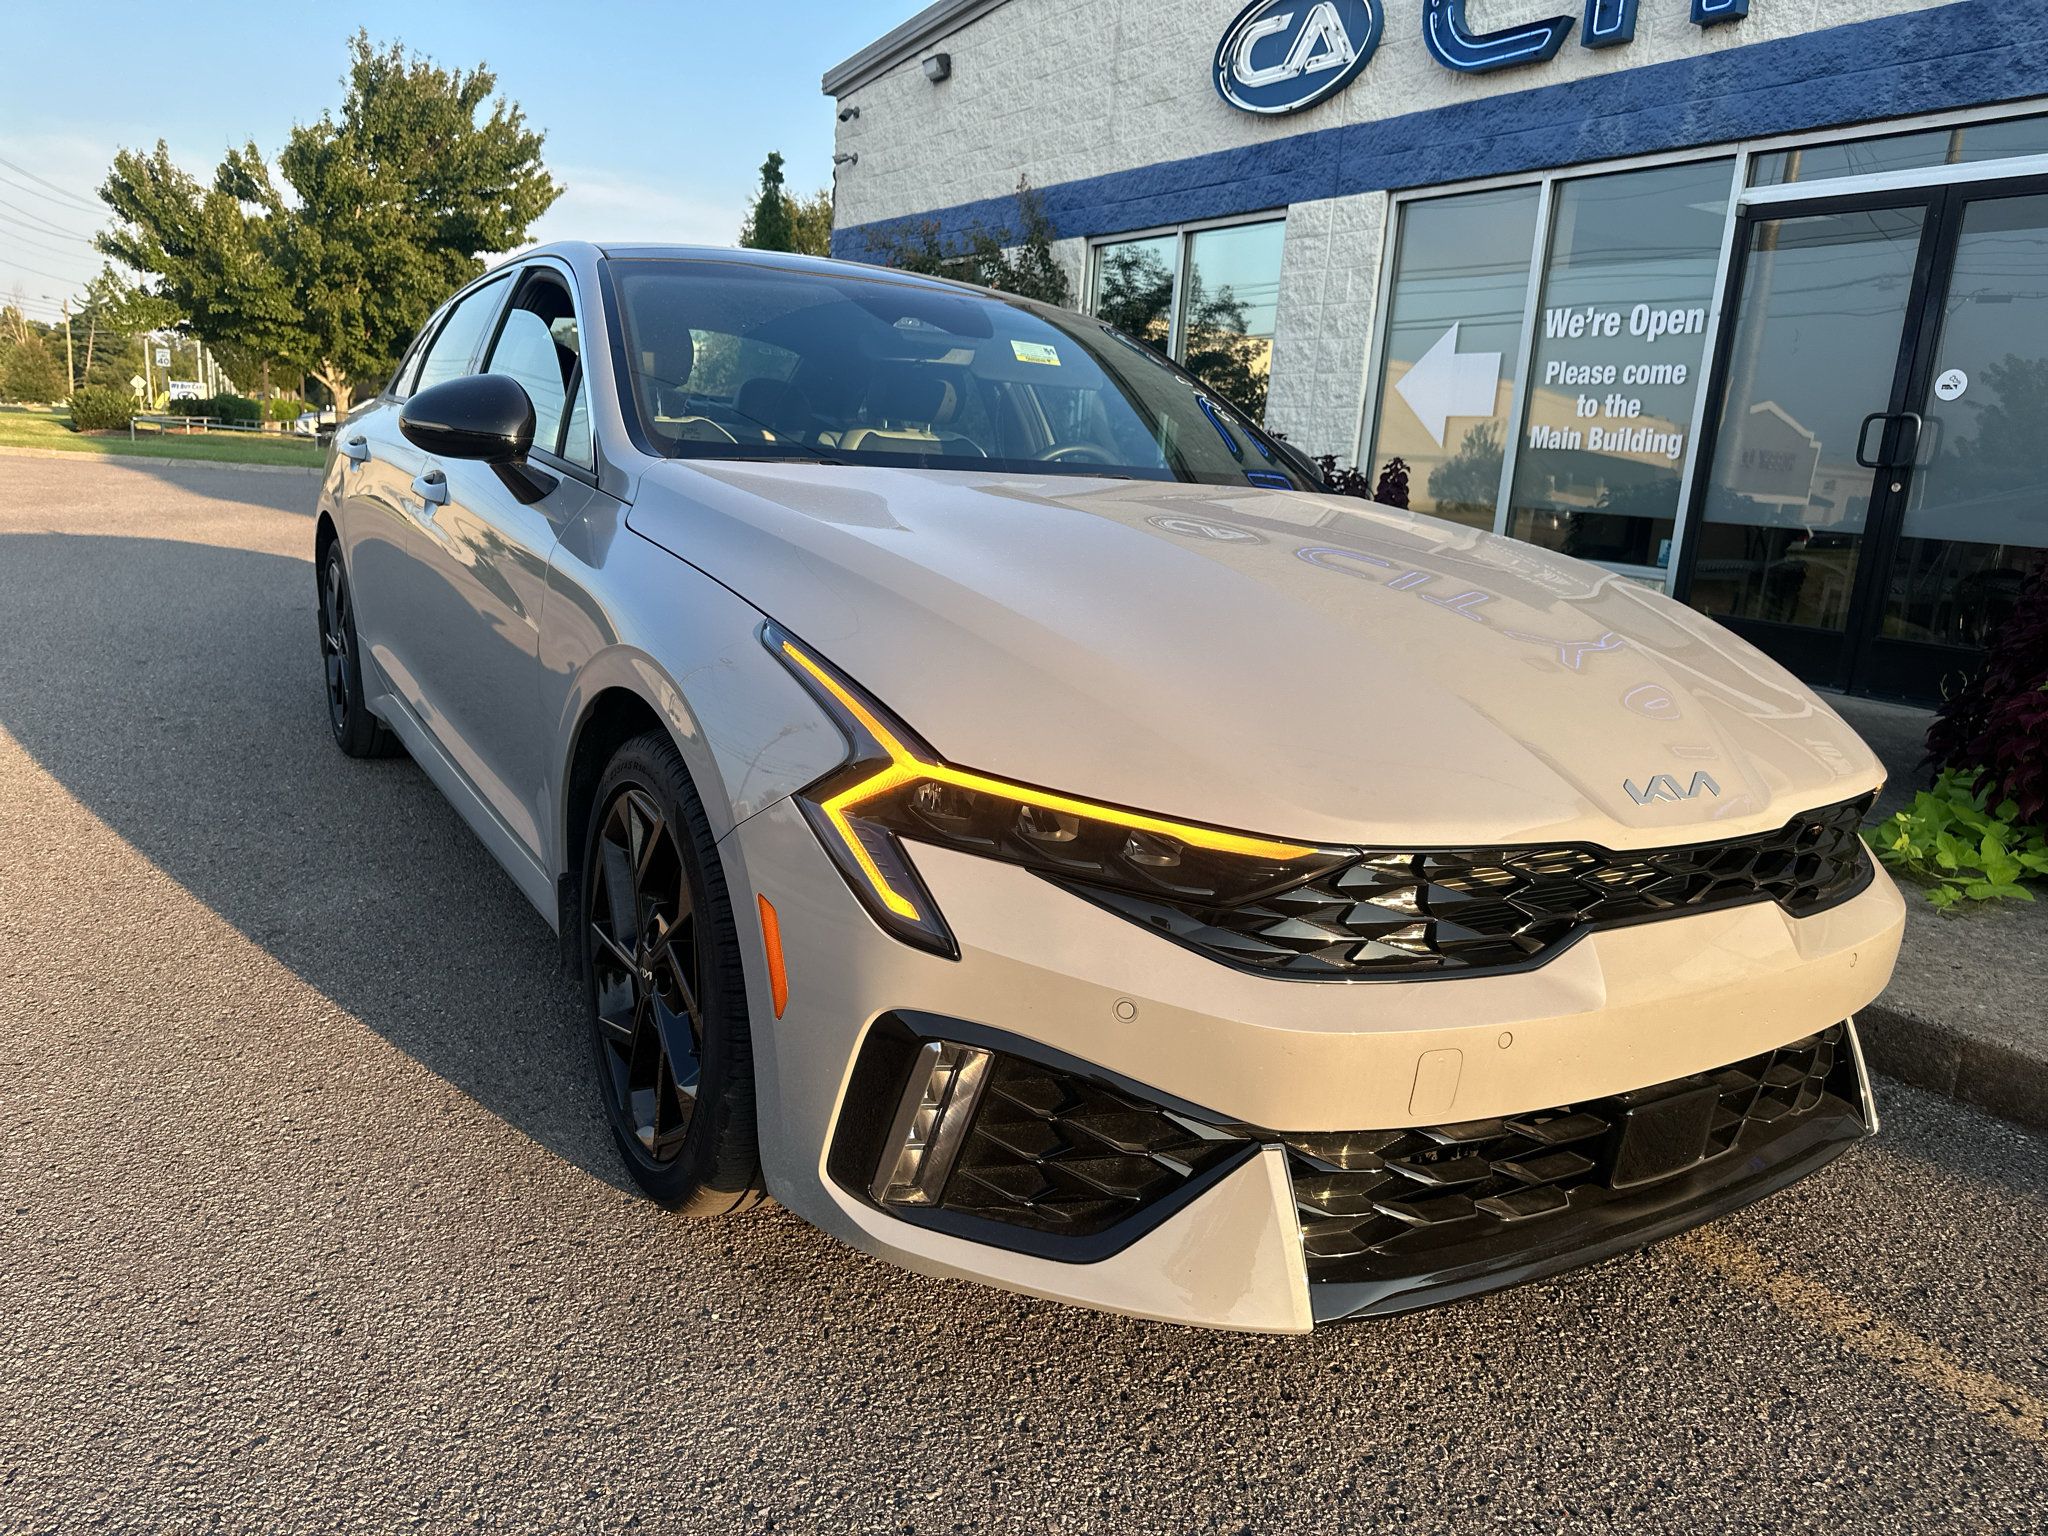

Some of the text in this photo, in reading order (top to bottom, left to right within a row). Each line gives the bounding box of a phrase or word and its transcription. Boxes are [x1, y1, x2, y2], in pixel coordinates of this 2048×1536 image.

[1233, 0, 1357, 89] CA
[1545, 304, 1706, 343] We're Open
[157, 357, 169, 365] 40
[1544, 361, 1687, 385] Please come
[1576, 394, 1641, 419] to the
[1529, 426, 1683, 460] Main Building
[1623, 770, 1721, 806] KIA
